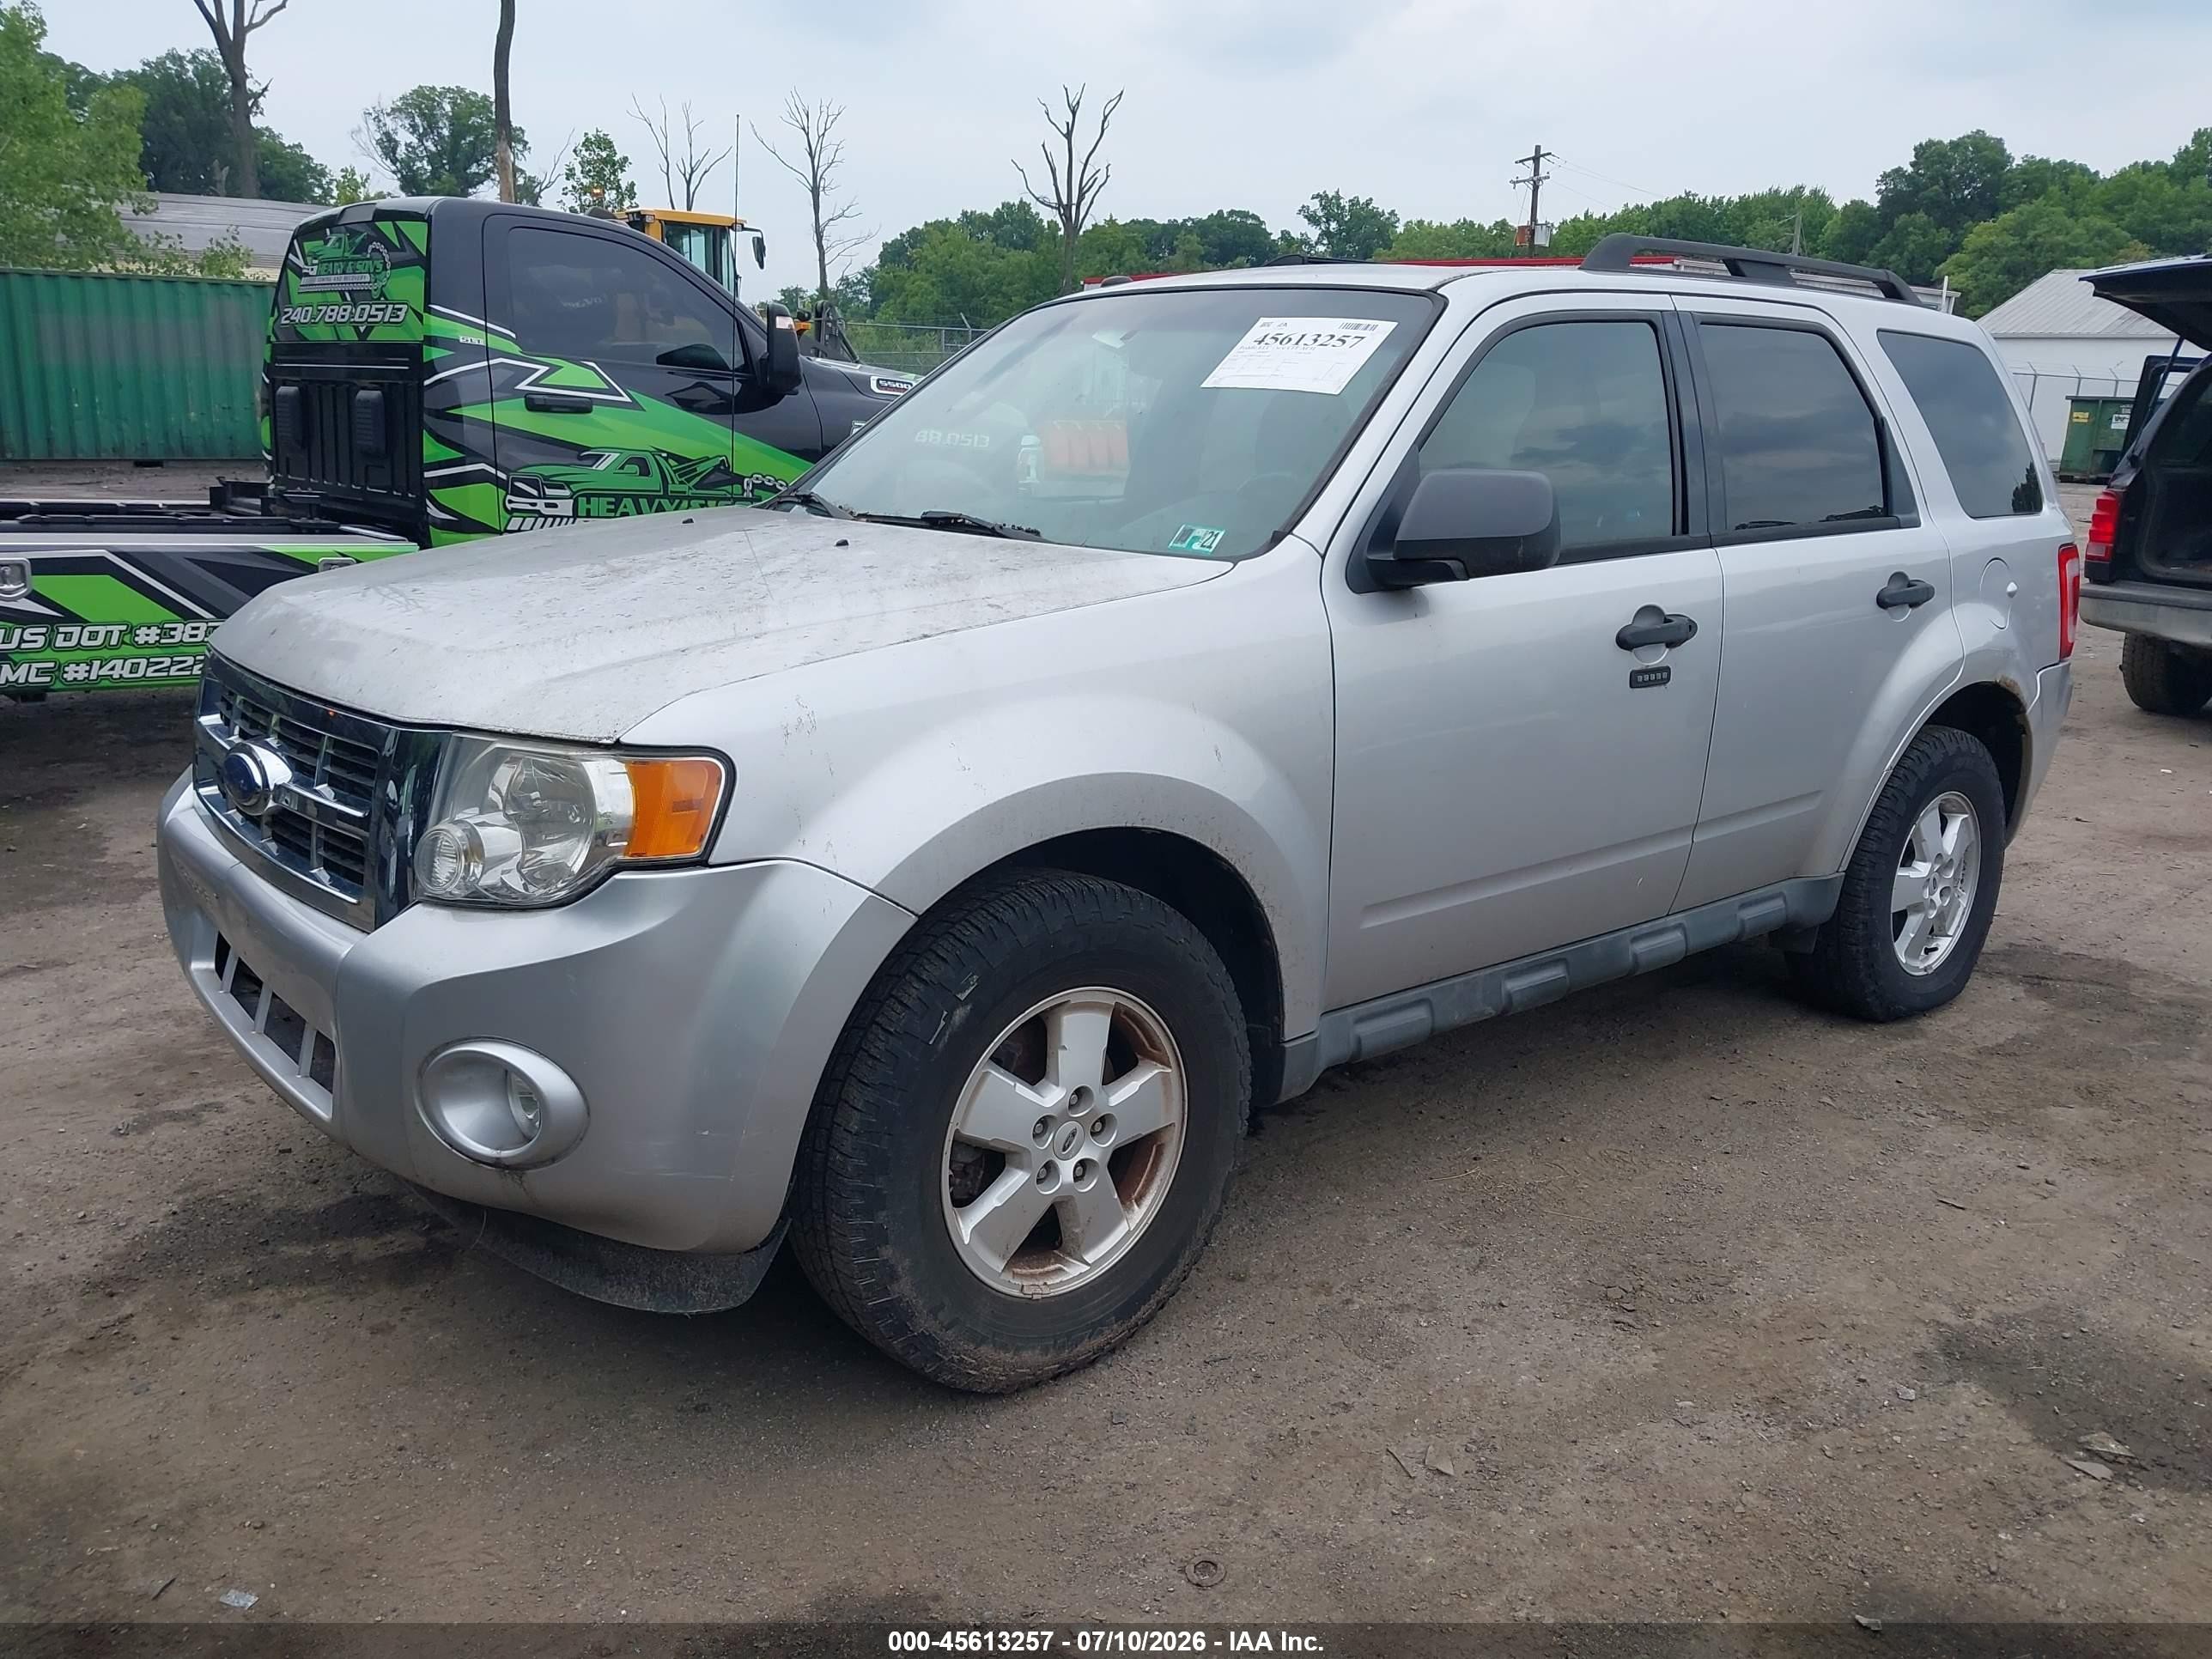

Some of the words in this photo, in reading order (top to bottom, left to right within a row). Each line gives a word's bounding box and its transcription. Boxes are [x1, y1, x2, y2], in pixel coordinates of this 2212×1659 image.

[280, 303, 409, 325] 240.788.0513
[1253, 331, 1367, 349] 45613257
[878, 380, 911, 389] 5500
[578, 497, 680, 517] HEAVY
[0, 627, 47, 650] US
[54, 624, 129, 647] DOT
[0, 662, 56, 684] MC
